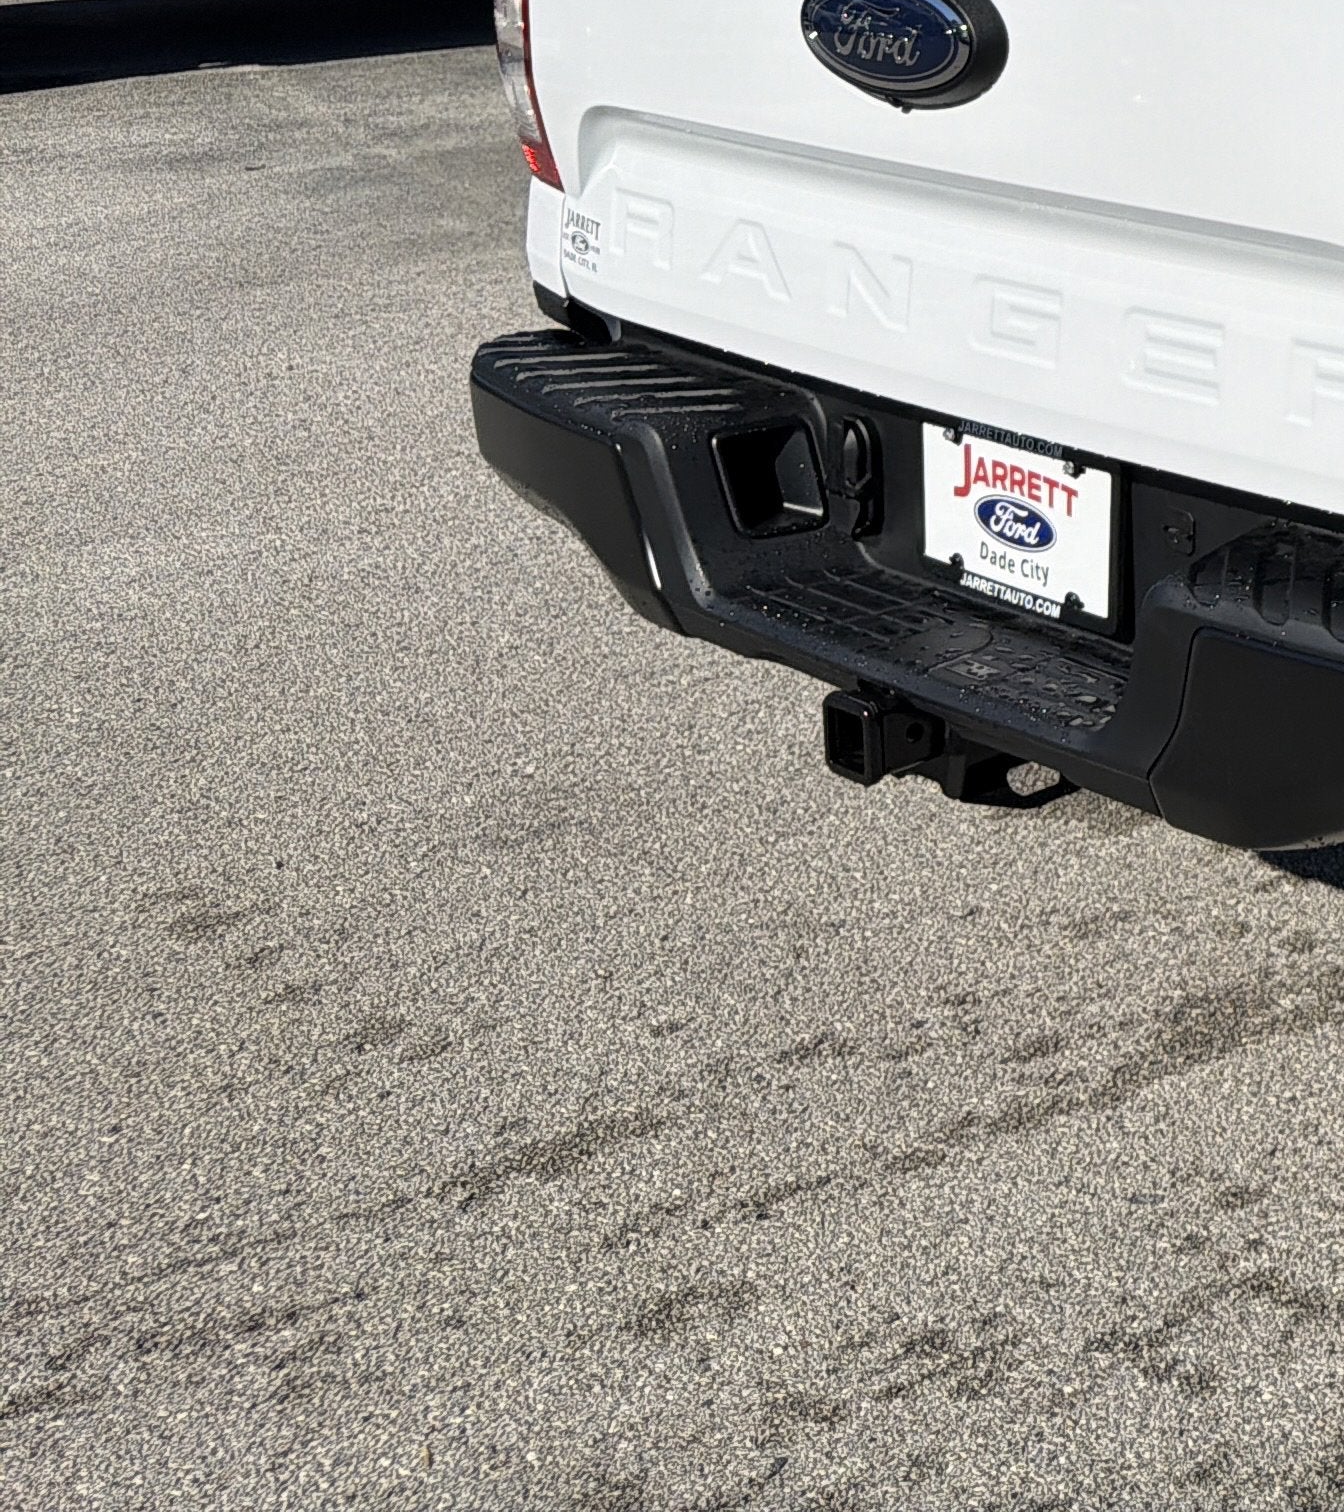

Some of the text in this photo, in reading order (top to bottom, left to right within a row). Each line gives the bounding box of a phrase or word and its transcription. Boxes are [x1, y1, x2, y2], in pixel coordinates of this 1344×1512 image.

[565, 208, 601, 241] JARRETT
[957, 420, 1063, 458] JARRETTAUTO.COM
[953, 443, 1079, 518] JARRETT
[989, 501, 1041, 545] Ford
[979, 541, 1050, 587] Dade City
[959, 573, 1062, 619] JARRETTAUTO.COM
